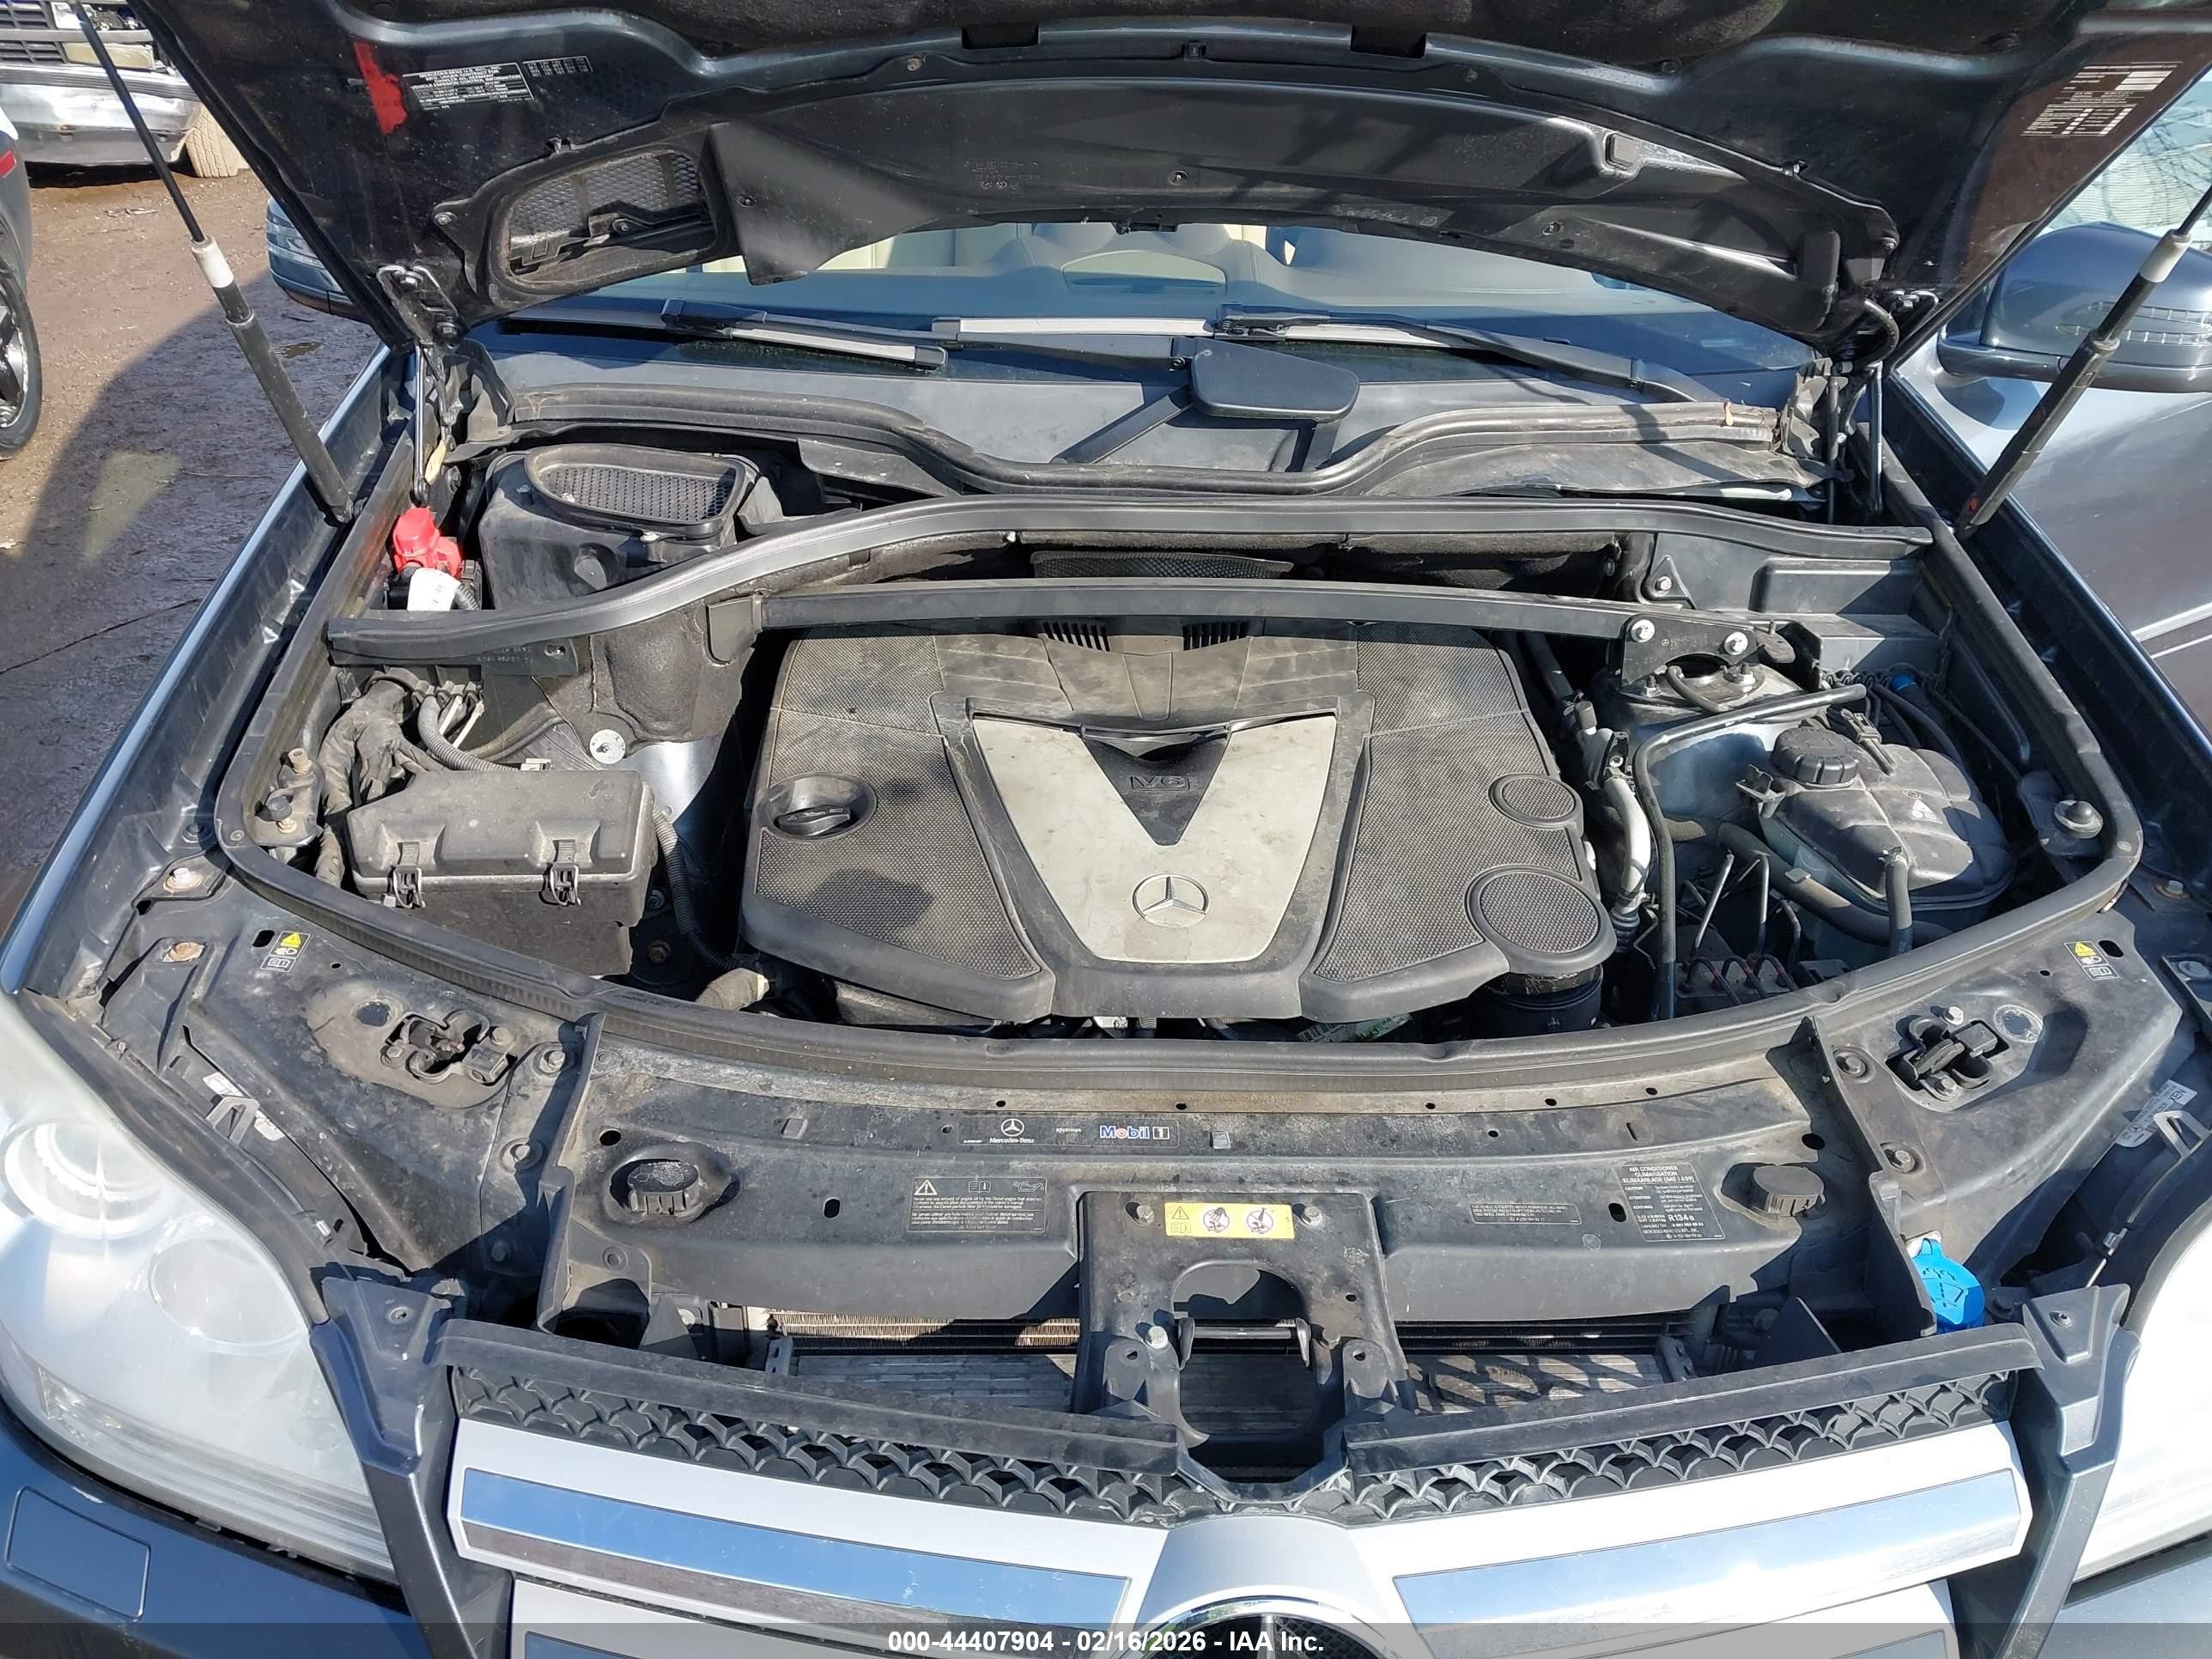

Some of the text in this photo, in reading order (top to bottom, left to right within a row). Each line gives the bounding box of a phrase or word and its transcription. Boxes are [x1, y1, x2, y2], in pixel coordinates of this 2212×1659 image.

[1133, 775, 1185, 787] V6
[1100, 1125, 1150, 1140] Mobil
[1668, 1213, 1696, 1222] R134a
